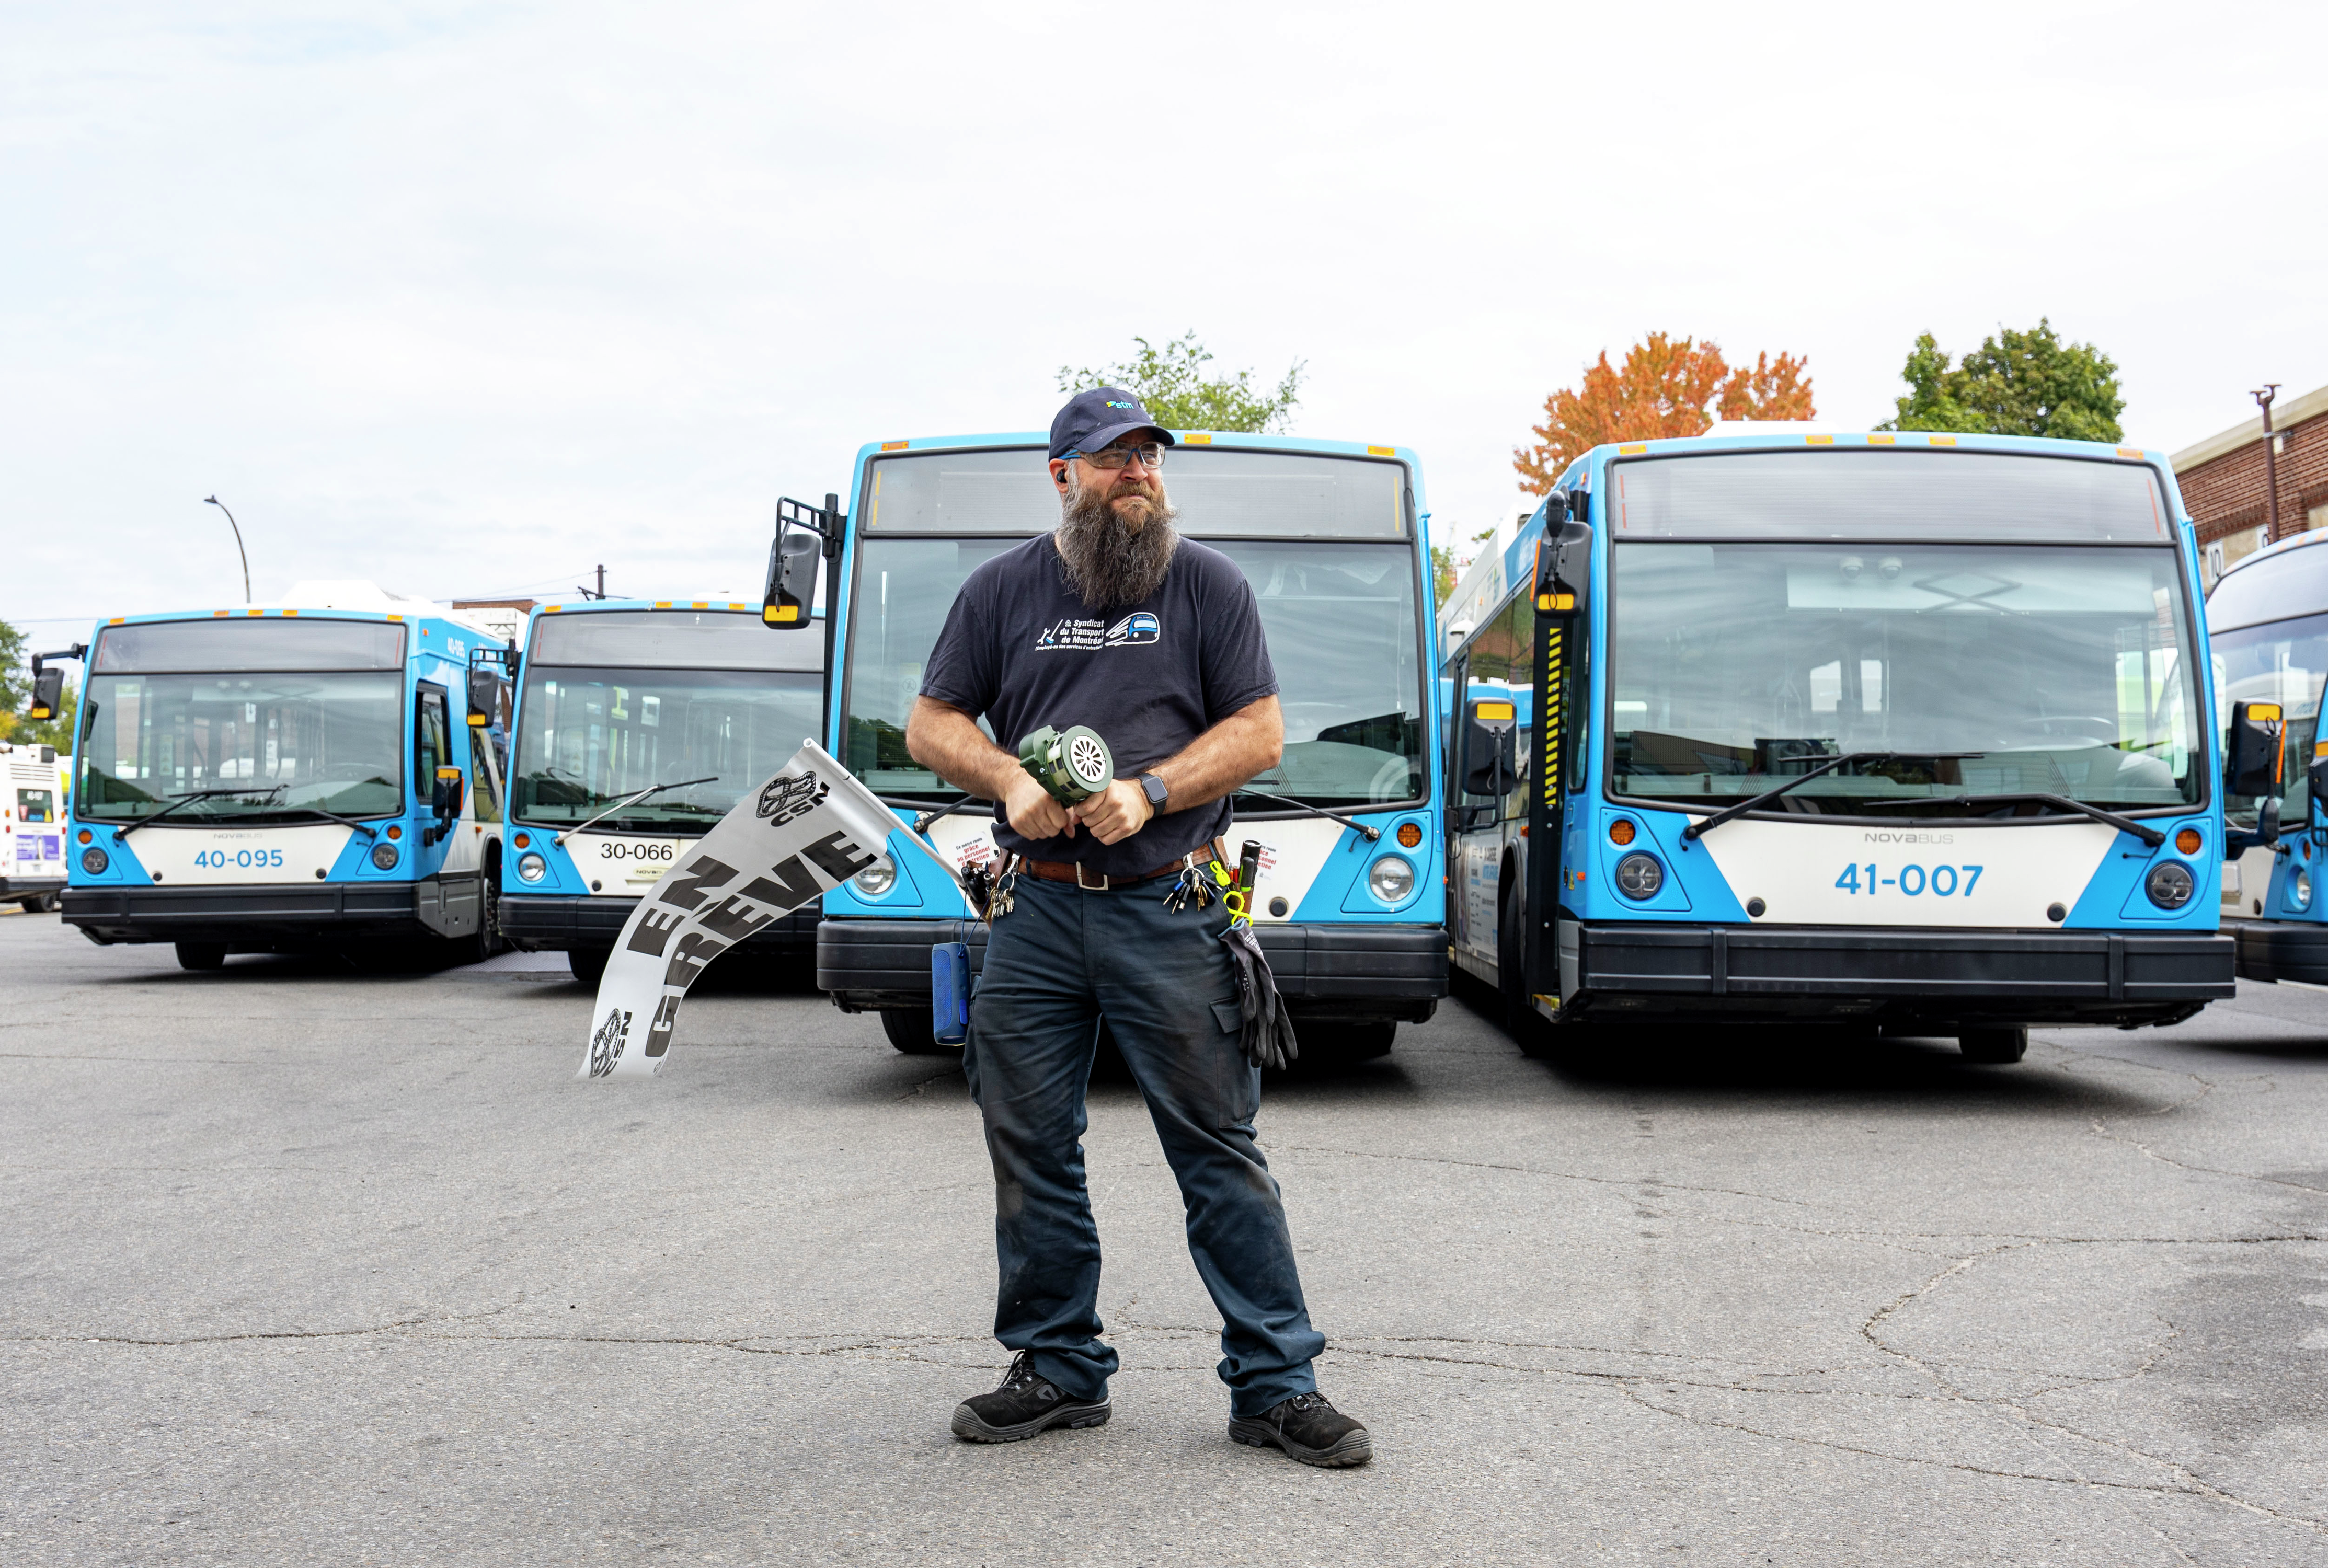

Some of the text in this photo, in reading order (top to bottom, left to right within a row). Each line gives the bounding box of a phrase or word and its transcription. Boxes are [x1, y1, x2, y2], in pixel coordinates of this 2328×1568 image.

[1116, 400, 1134, 409] stm
[2210, 549, 2222, 580] 10
[1073, 619, 1104, 628] Syndicat
[1072, 628, 1104, 637] Transport
[1072, 636, 1104, 644] Montréal
[771, 781, 830, 827] CSN
[601, 843, 672, 860] 30-066
[964, 845, 979, 853] grâce
[965, 846, 990, 860] personnel
[194, 850, 283, 868] 40-095
[1835, 863, 1983, 896] 41-007
[627, 855, 740, 958] EN
[645, 830, 878, 1057] GRÈVE
[601, 1011, 633, 1078] CSN
